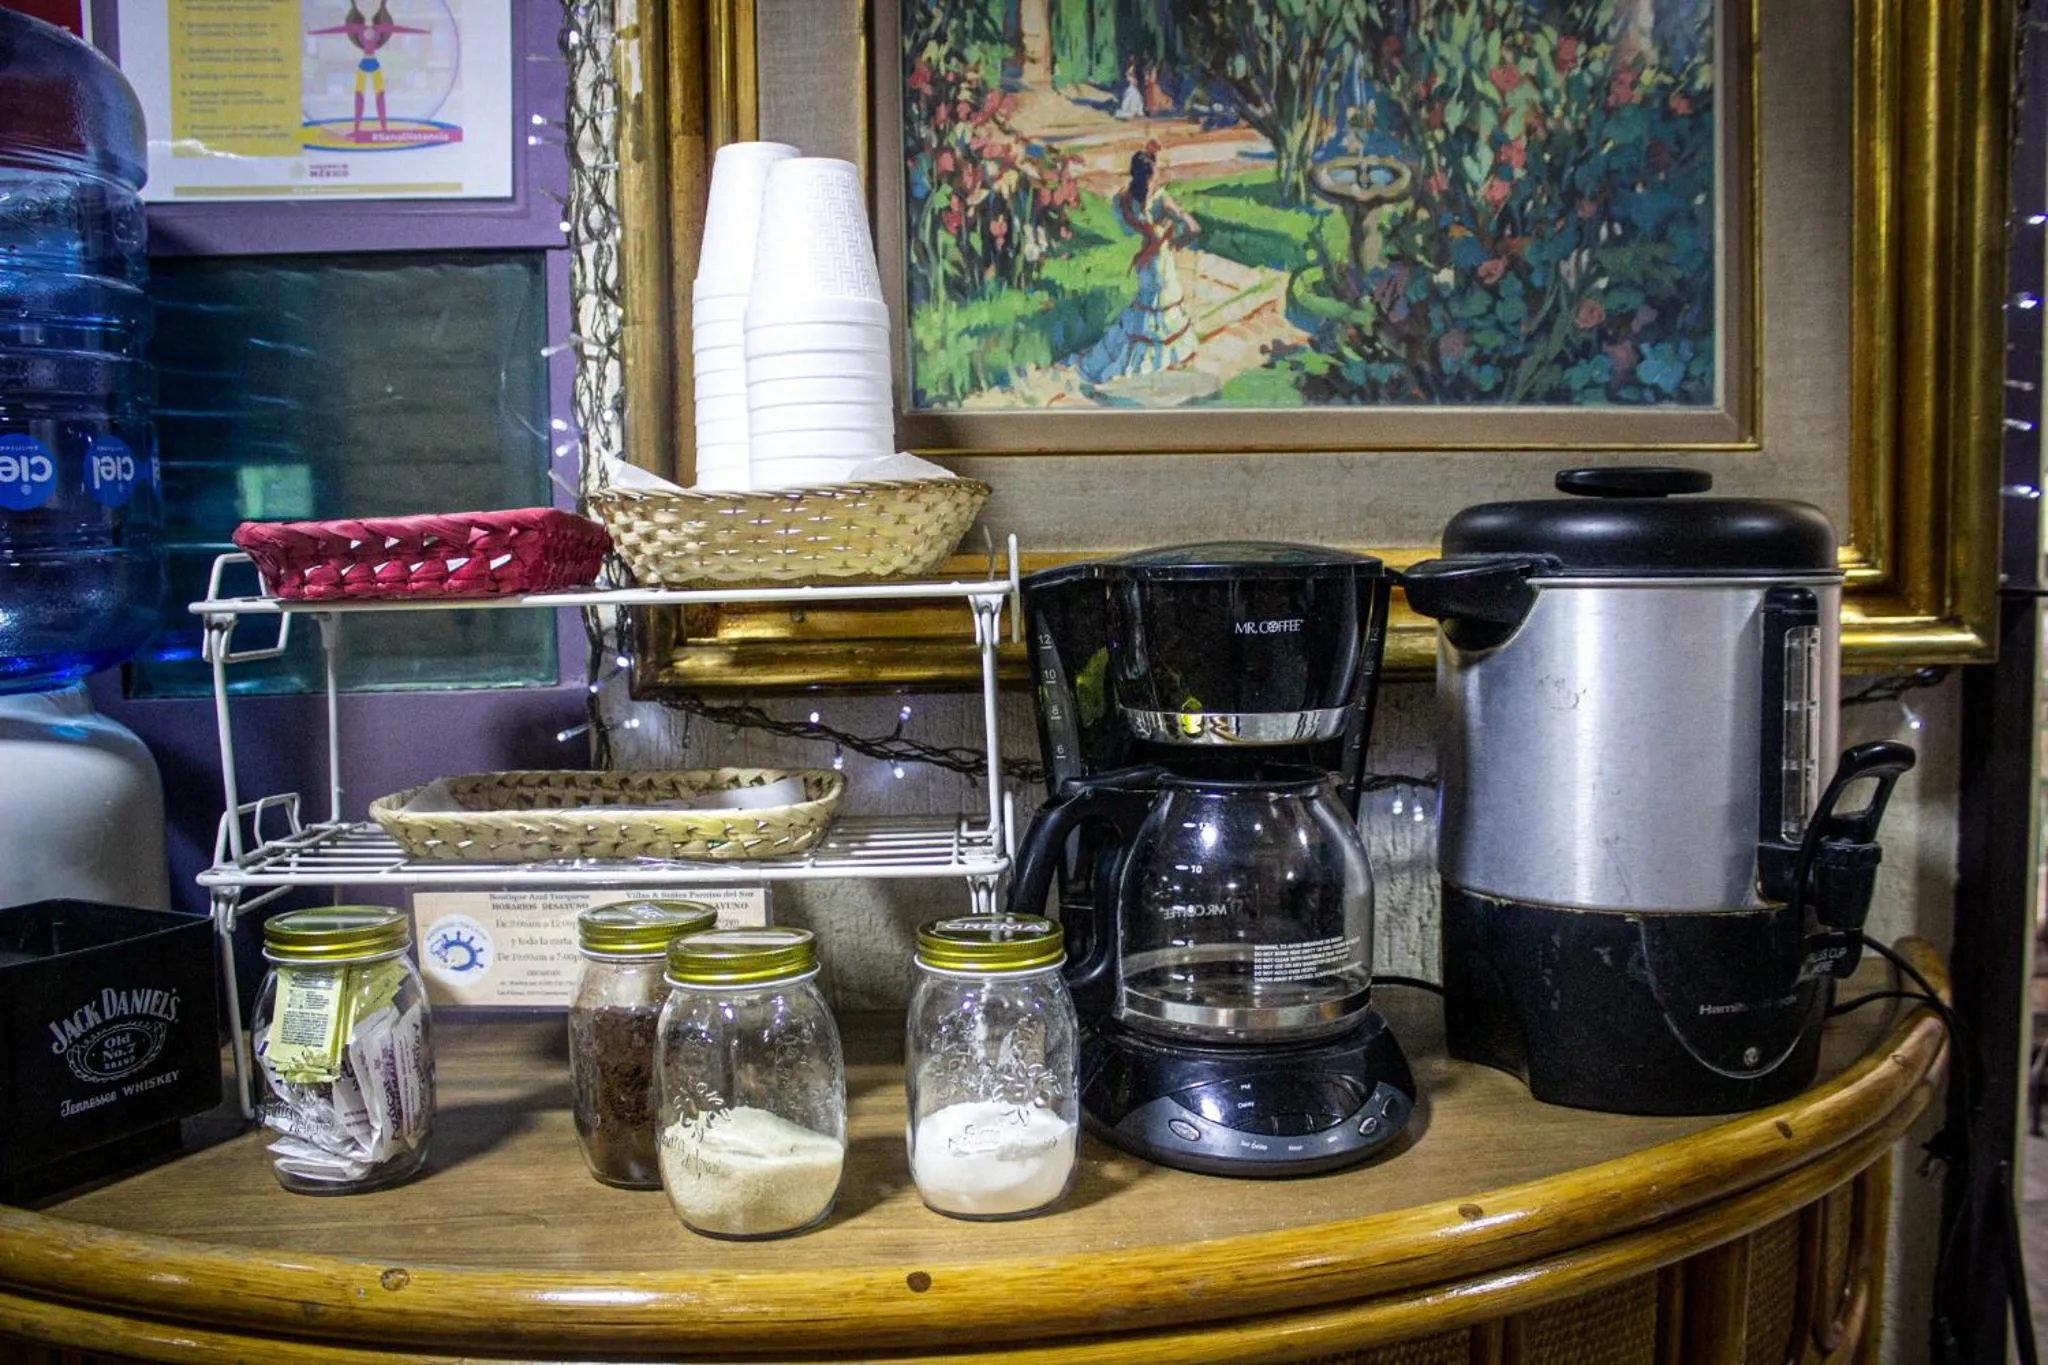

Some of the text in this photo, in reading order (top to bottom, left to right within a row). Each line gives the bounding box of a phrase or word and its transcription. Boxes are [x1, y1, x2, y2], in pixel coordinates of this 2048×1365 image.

[0, 455, 53, 496] cie
[92, 455, 135, 493] ciel
[1234, 619, 1302, 634] MR. COFFEE
[1038, 634, 1051, 645] 12
[1043, 669, 1057, 680] 10
[1056, 743, 1065, 755] 6
[1190, 865, 1203, 874] 10
[714, 902, 749, 910] AYUNO
[518, 935, 538, 945] toda
[540, 935, 548, 945] la
[49, 1001, 103, 1055] JACK
[104, 1033, 131, 1048] Old
[61, 1069, 180, 1118] Tennessee WHISKEY
